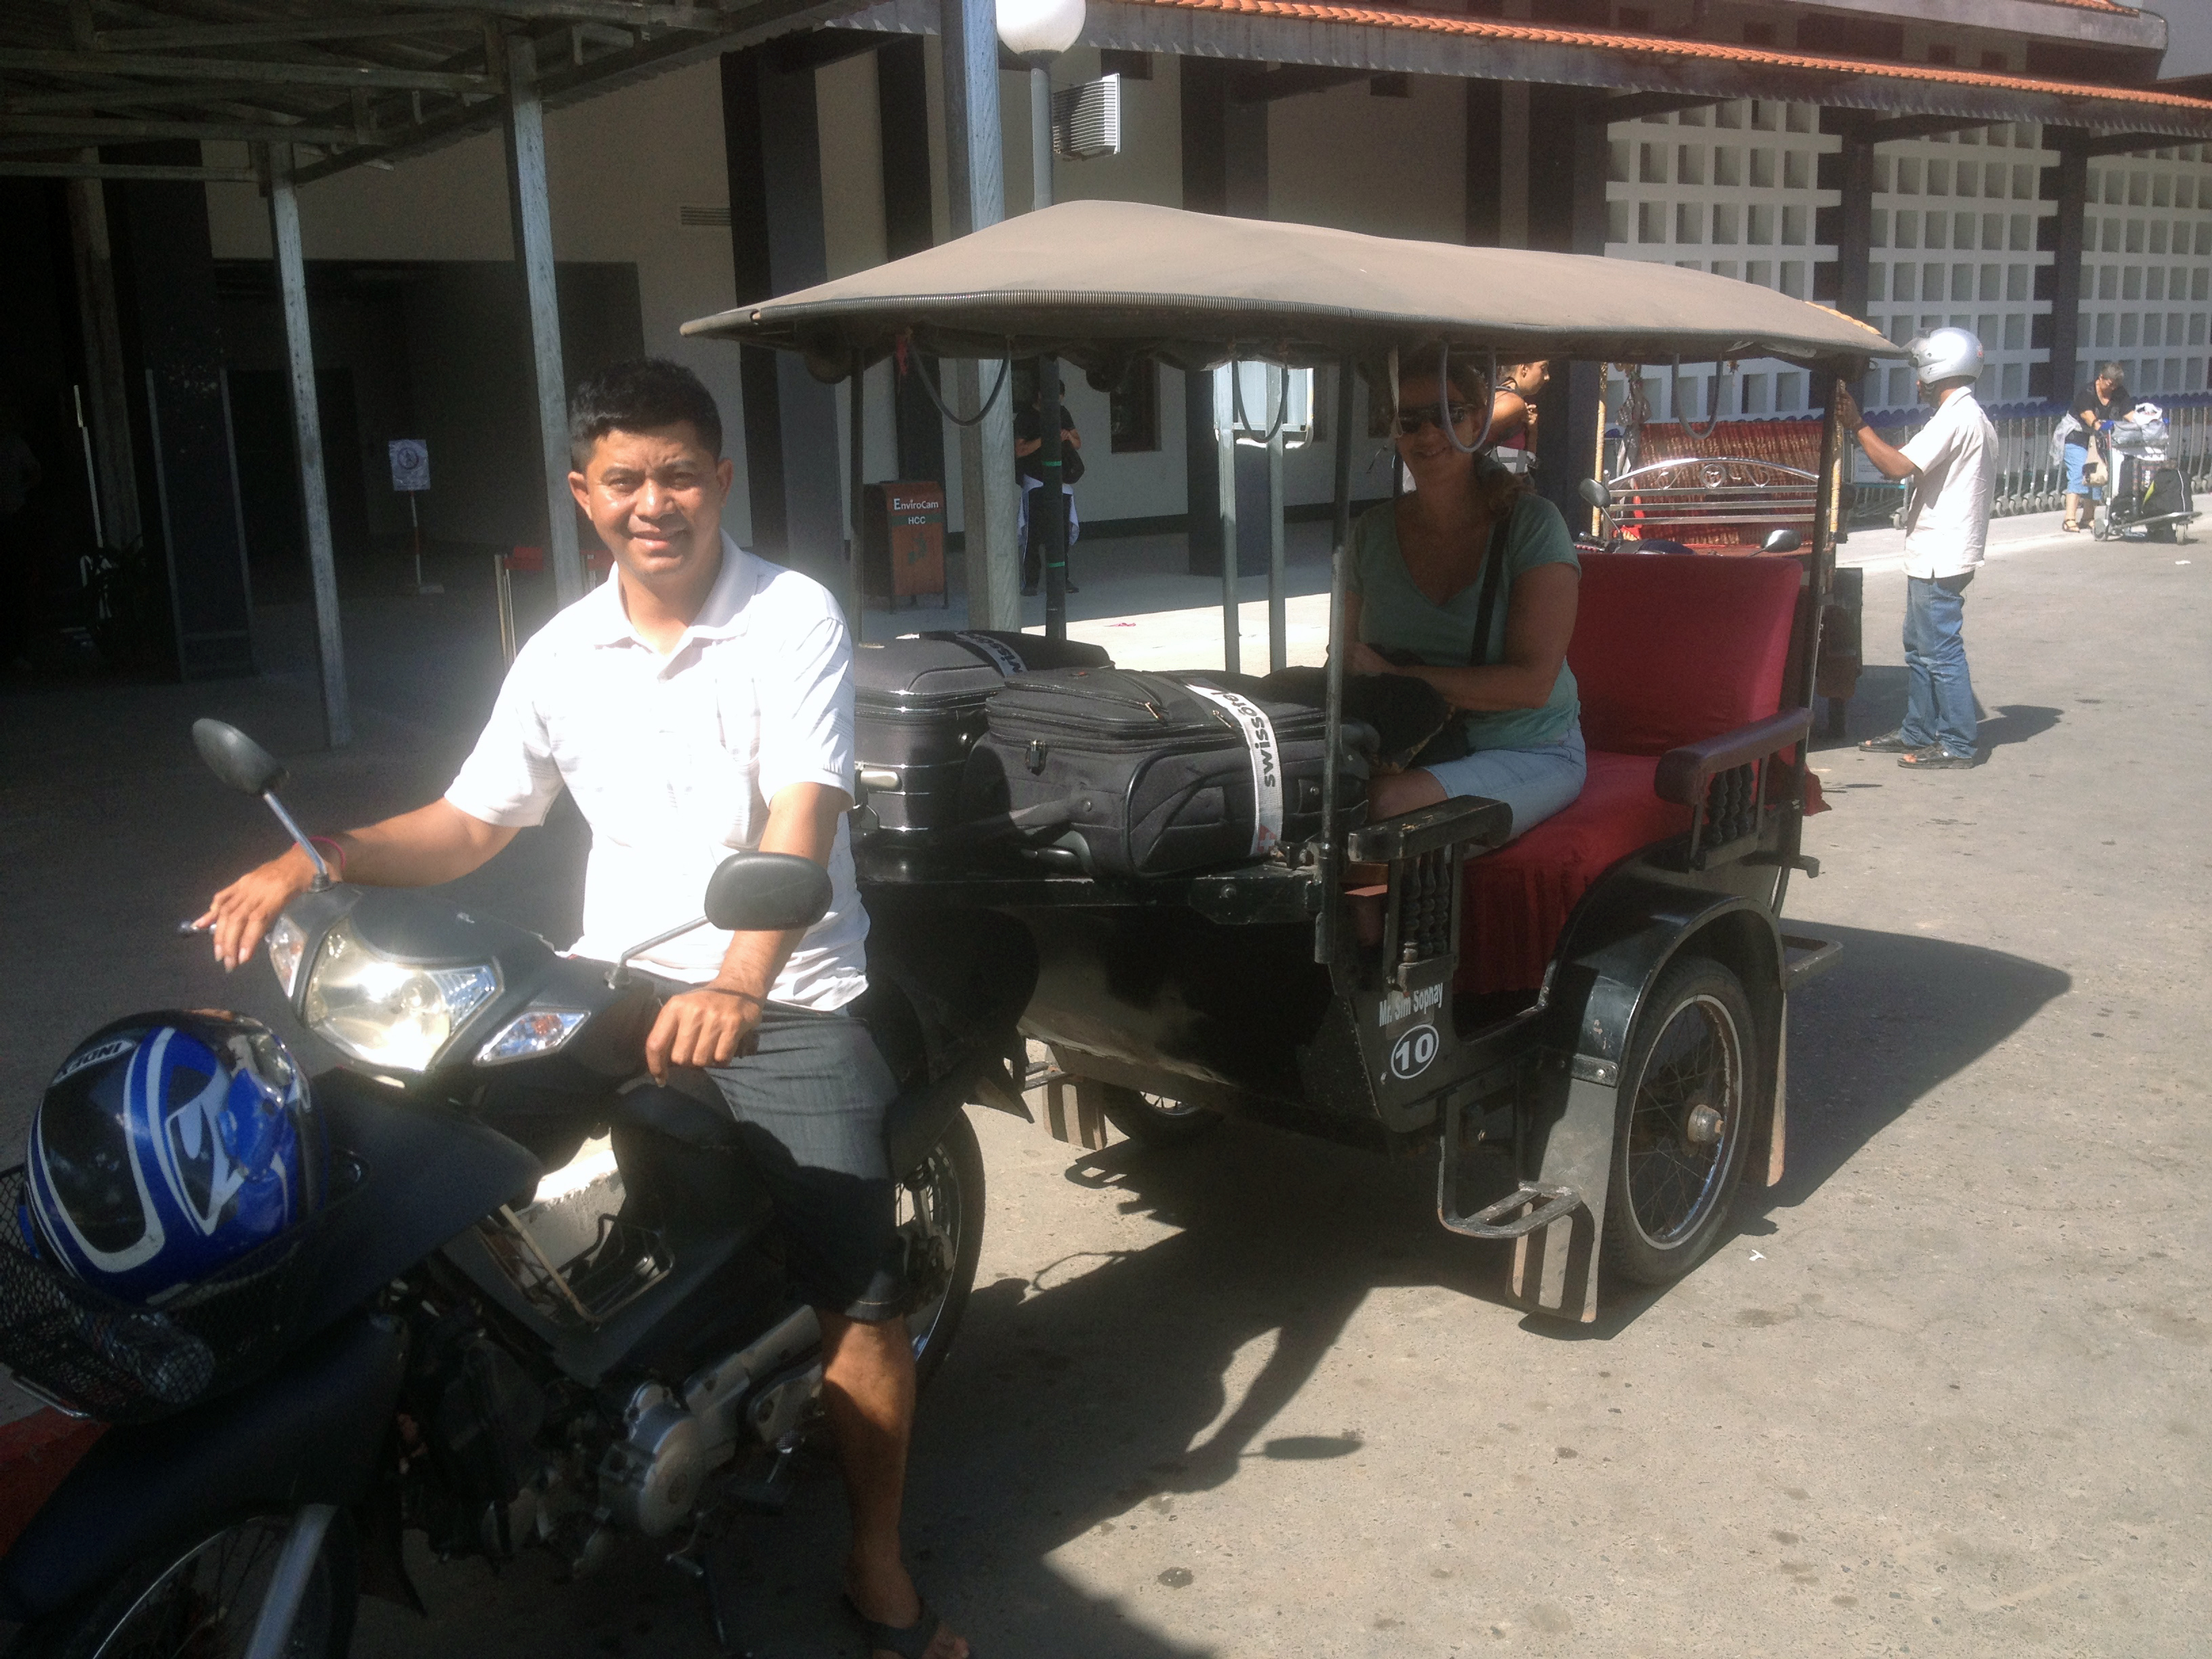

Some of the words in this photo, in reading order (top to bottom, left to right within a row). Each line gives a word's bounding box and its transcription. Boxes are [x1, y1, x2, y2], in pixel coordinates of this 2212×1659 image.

[894, 498, 939, 510] EnviroCam
[908, 516, 926, 525] HCC
[1379, 999, 1393, 1027] Mr.
[1395, 1033, 1435, 1071] 10
